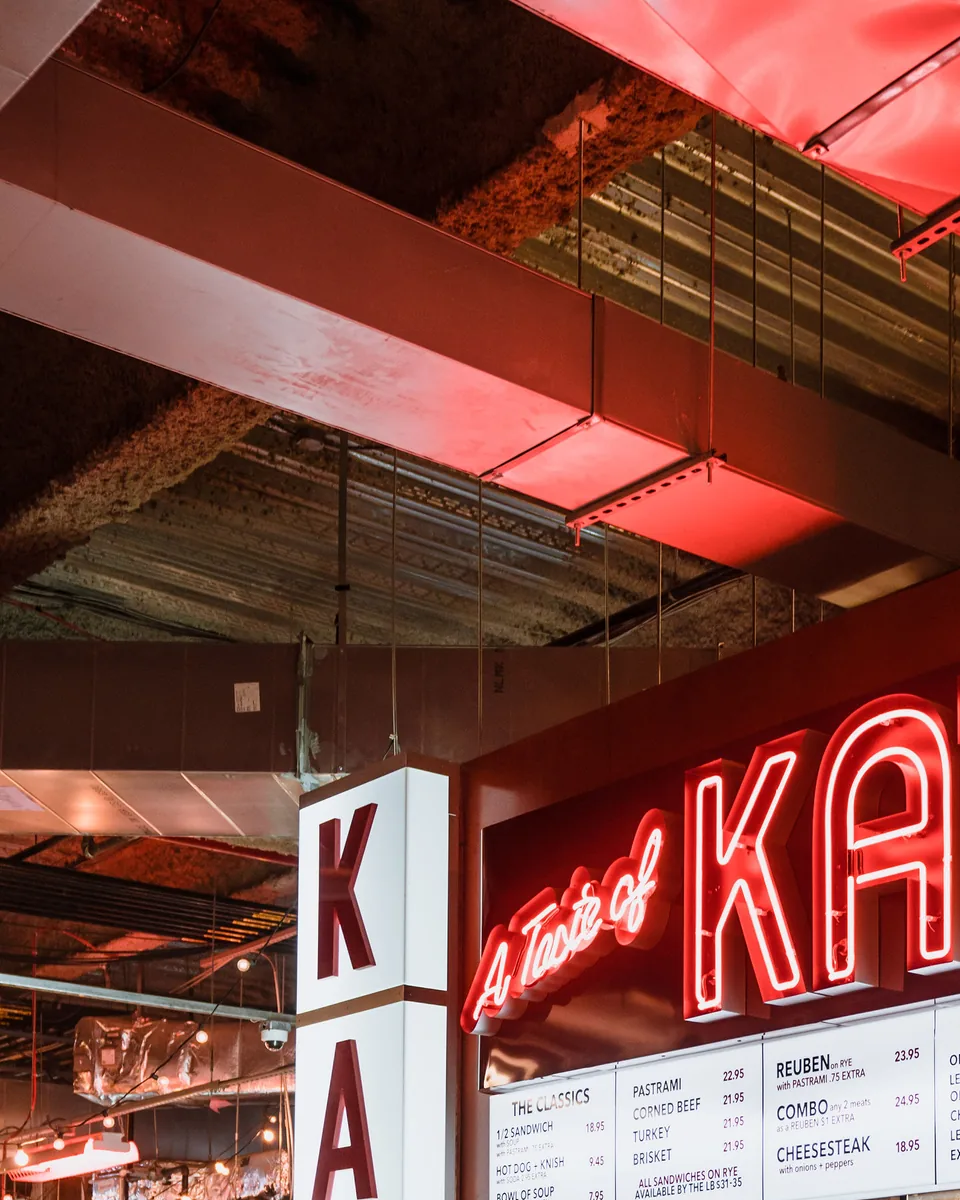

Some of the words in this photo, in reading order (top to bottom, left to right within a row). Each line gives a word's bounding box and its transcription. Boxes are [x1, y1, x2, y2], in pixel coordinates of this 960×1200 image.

[464, 926, 512, 1030] A
[516, 872, 604, 990] Taste
[604, 812, 665, 942] of
[895, 1048, 919, 1062] 23.95
[777, 1054, 830, 1078] REUBEN
[840, 1058, 852, 1068] RYE
[723, 1068, 744, 1081] 22.95
[777, 1081, 791, 1091] with
[793, 1074, 827, 1088] PASTRAMI
[829, 1072, 840, 1082] .75
[842, 1069, 865, 1080] EXTRA
[634, 1078, 681, 1098] PASTRAMI
[512, 1099, 532, 1116] THE
[537, 1088, 590, 1112] CLASSICS
[723, 1092, 744, 1105] 21.95
[895, 1094, 919, 1107] 24.95
[633, 1102, 673, 1120] CORNED
[677, 1098, 700, 1113] BEEF
[777, 1099, 828, 1120] COMBO
[830, 1102, 842, 1113] any
[844, 1101, 848, 1109] 2
[850, 1098, 871, 1108] meats
[497, 1129, 508, 1139] 1/2
[511, 1121, 553, 1137] SANDWICH
[586, 1121, 604, 1132] 18.95
[724, 1116, 744, 1128] 21.95
[791, 1118, 818, 1130] REUBEN
[832, 1114, 855, 1124] EXTRA
[633, 1126, 670, 1142] TURKEY
[724, 1140, 744, 1152] 21.95
[777, 1136, 870, 1162] CHEESESTEAK
[896, 1139, 919, 1153] 18.95
[589, 1156, 604, 1166] 9.45
[634, 1149, 672, 1165] BRISKET
[496, 1165, 512, 1176] HOT
[514, 1162, 531, 1173] DOG
[540, 1157, 564, 1169] KNISH
[779, 1163, 793, 1174] with
[795, 1161, 817, 1172] onions
[825, 1159, 854, 1171] peppers
[639, 1177, 651, 1188] ALL
[654, 1170, 705, 1187] SANDWICHES
[708, 1168, 720, 1179] ON
[723, 1166, 738, 1177] RYE
[521, 1189, 531, 1200] OF
[533, 1186, 554, 1198] SOUP
[589, 1191, 603, 1200] 7.95
[635, 1187, 675, 1199] AVAILABLE
[677, 1184, 687, 1194] BY
[689, 1182, 703, 1193] THE
[706, 1181, 715, 1191] LB
